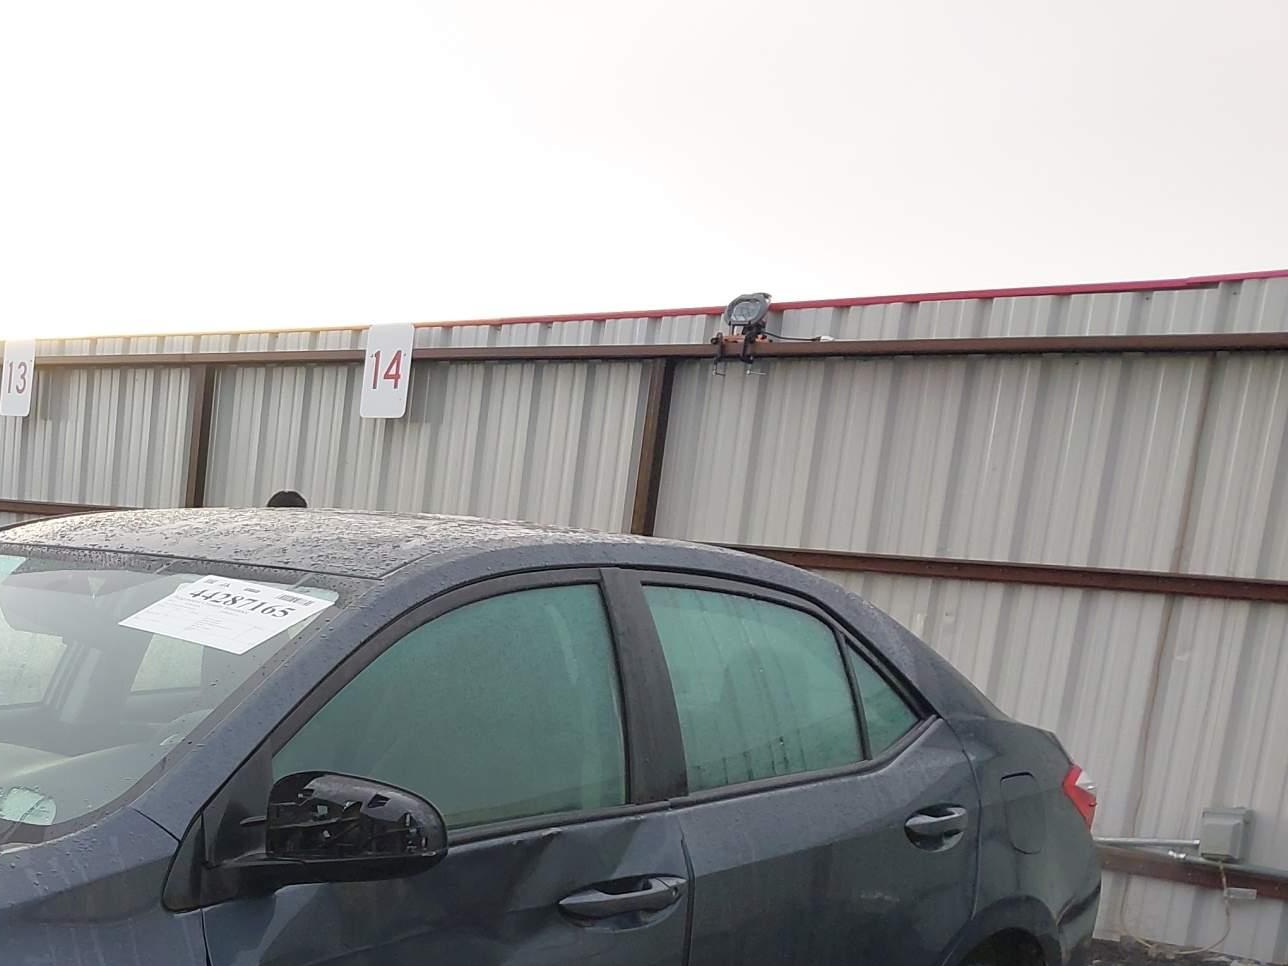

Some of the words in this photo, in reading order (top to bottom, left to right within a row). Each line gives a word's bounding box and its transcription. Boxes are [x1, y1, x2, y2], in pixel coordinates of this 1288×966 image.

[7, 361, 28, 394] 13
[372, 350, 402, 389] 14
[189, 589, 296, 618] 44287165
